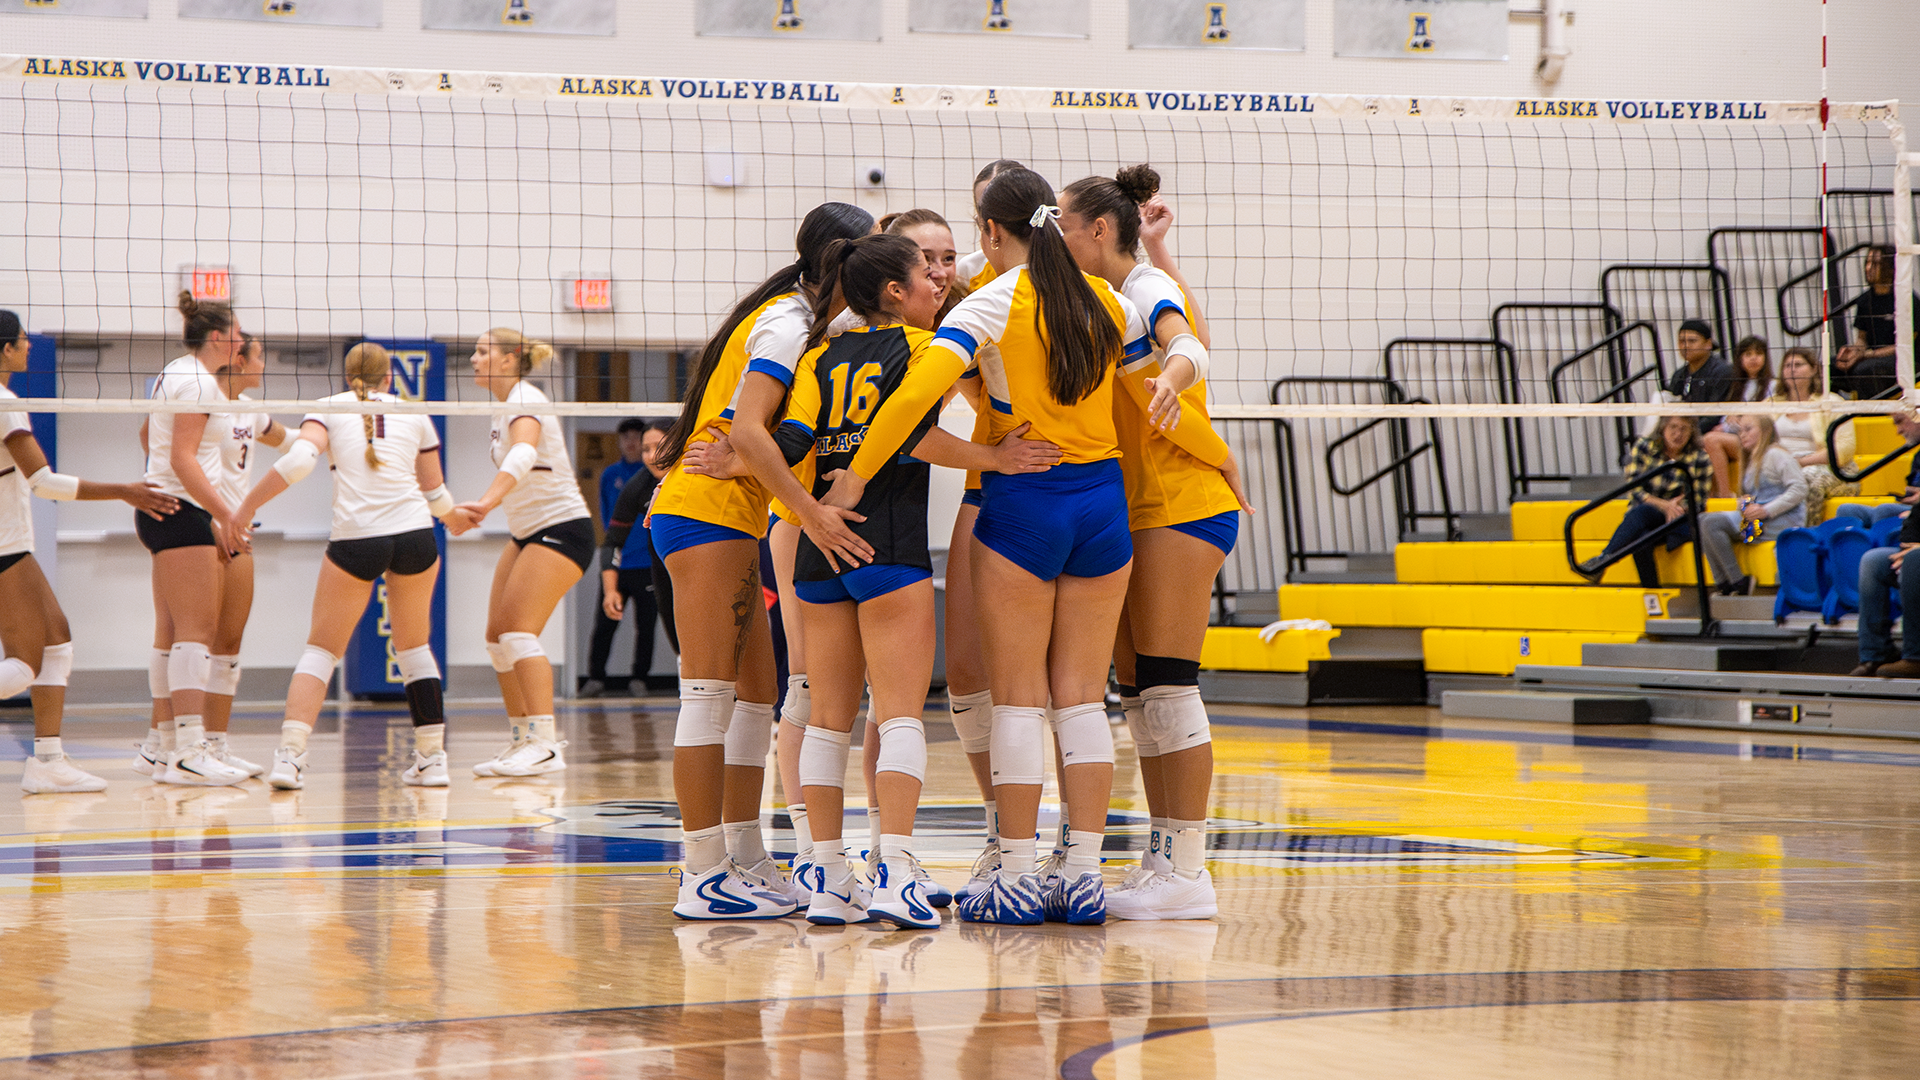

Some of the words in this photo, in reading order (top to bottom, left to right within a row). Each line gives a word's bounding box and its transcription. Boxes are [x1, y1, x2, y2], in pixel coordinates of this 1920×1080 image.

[24, 57, 126, 78] ALASKA
[134, 60, 331, 88] VOLLEYBALL
[560, 77, 653, 97] ALASKA
[660, 78, 841, 103] VOLLEYBALL
[1051, 90, 1138, 108] ALASKA
[1145, 91, 1315, 113] VOLLEYBALL
[1515, 100, 1599, 118] ALASKA
[1605, 100, 1767, 121] VOLLEYBALL
[827, 361, 883, 430] 16
